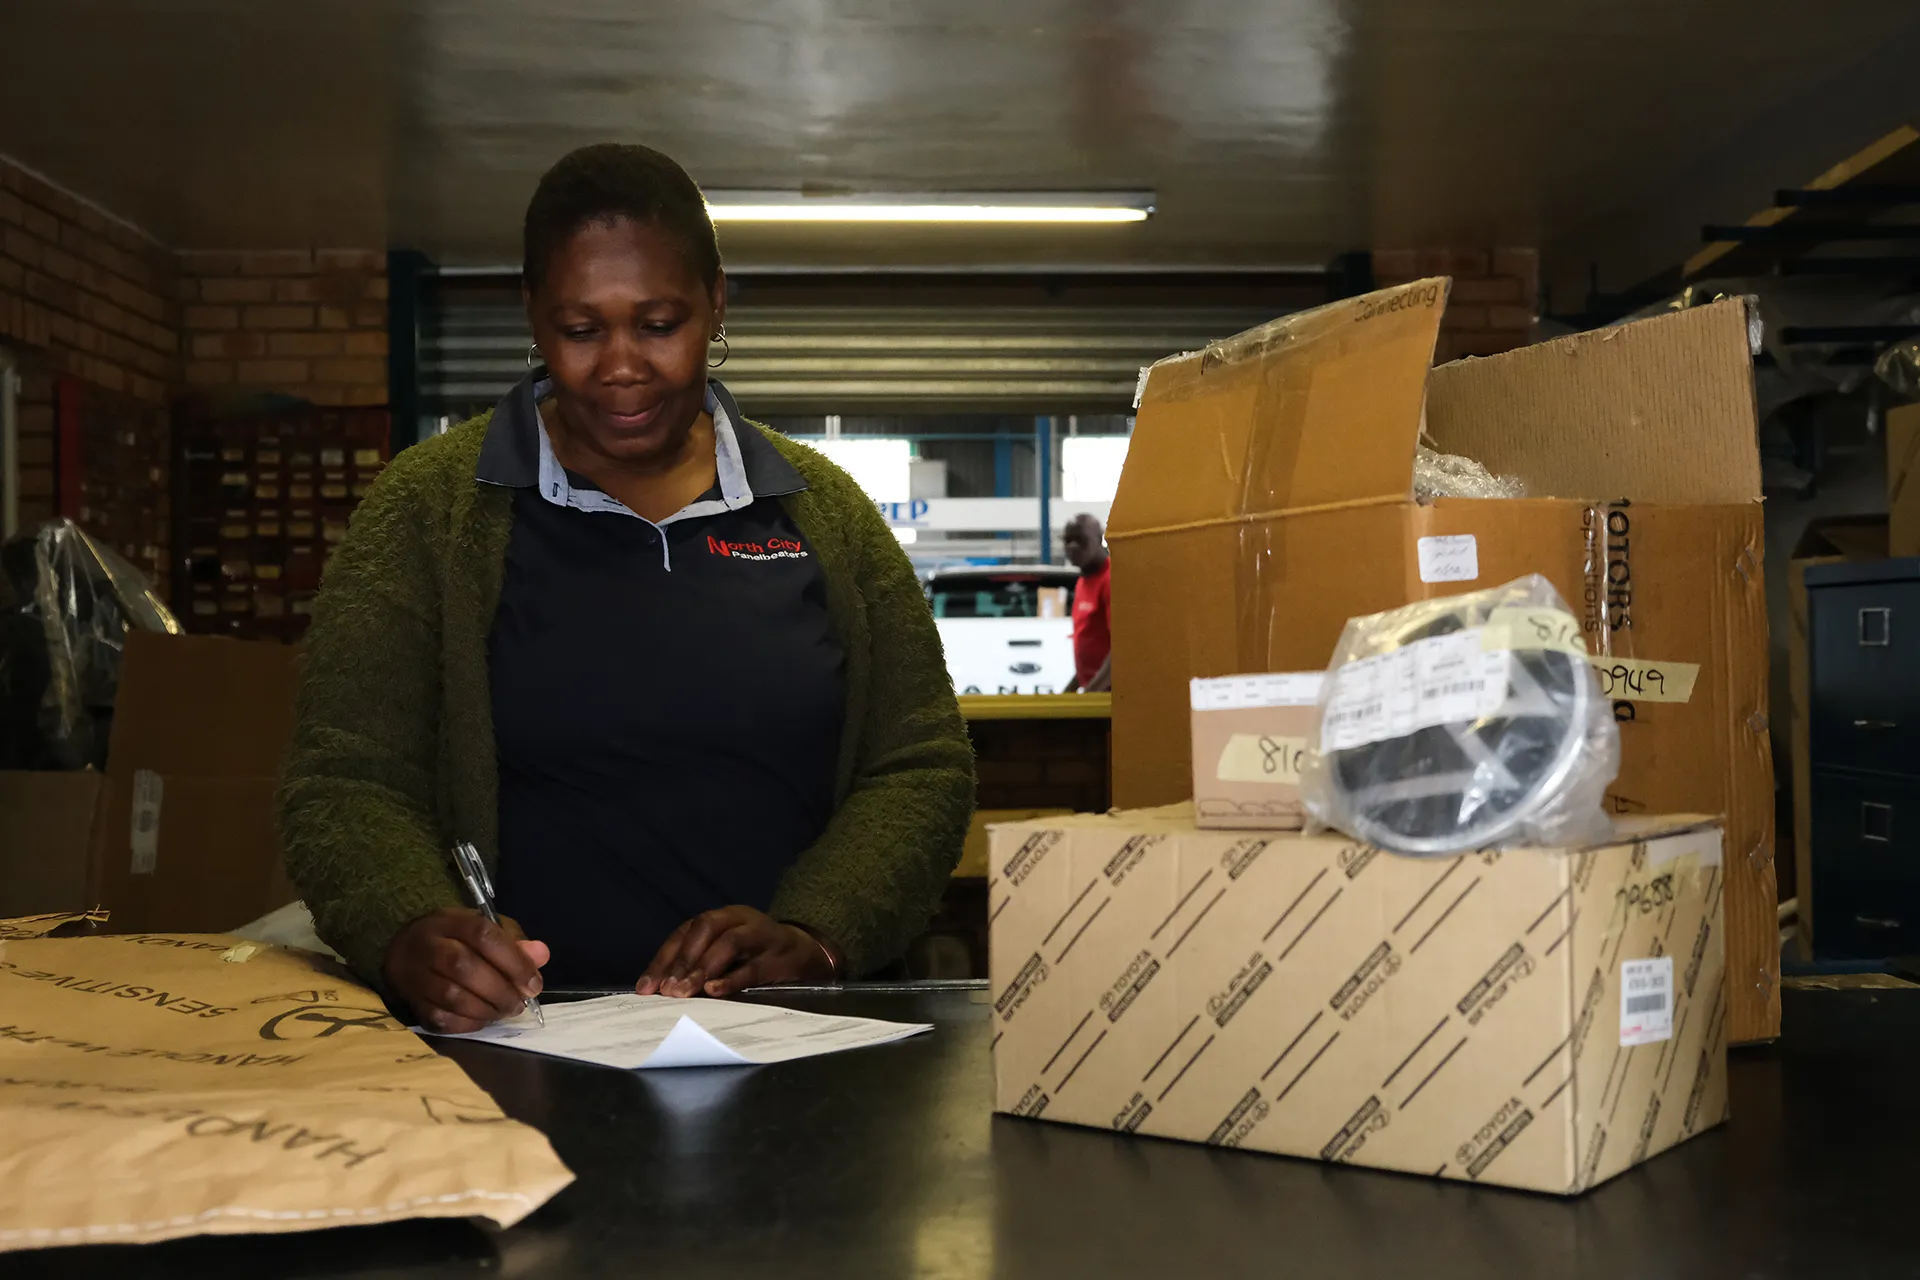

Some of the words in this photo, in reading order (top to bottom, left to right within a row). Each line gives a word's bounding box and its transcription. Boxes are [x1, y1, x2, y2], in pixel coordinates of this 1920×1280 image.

[1354, 284, 1438, 323] Connecting
[706, 535, 764, 556] North
[767, 537, 801, 551] City
[731, 550, 809, 561] Panelbeaters
[103, 935, 232, 952] ANDL
[1111, 949, 1152, 992] TOYOTA
[12, 969, 238, 1018] SENSITIVE
[1339, 973, 1384, 1022] TOYOTA
[1009, 1084, 1041, 1118] OYOTA
[1111, 1092, 1143, 1126] EXUS
[1224, 1117, 1255, 1150] TOYO
[1472, 1094, 1522, 1146] TOYOTA
